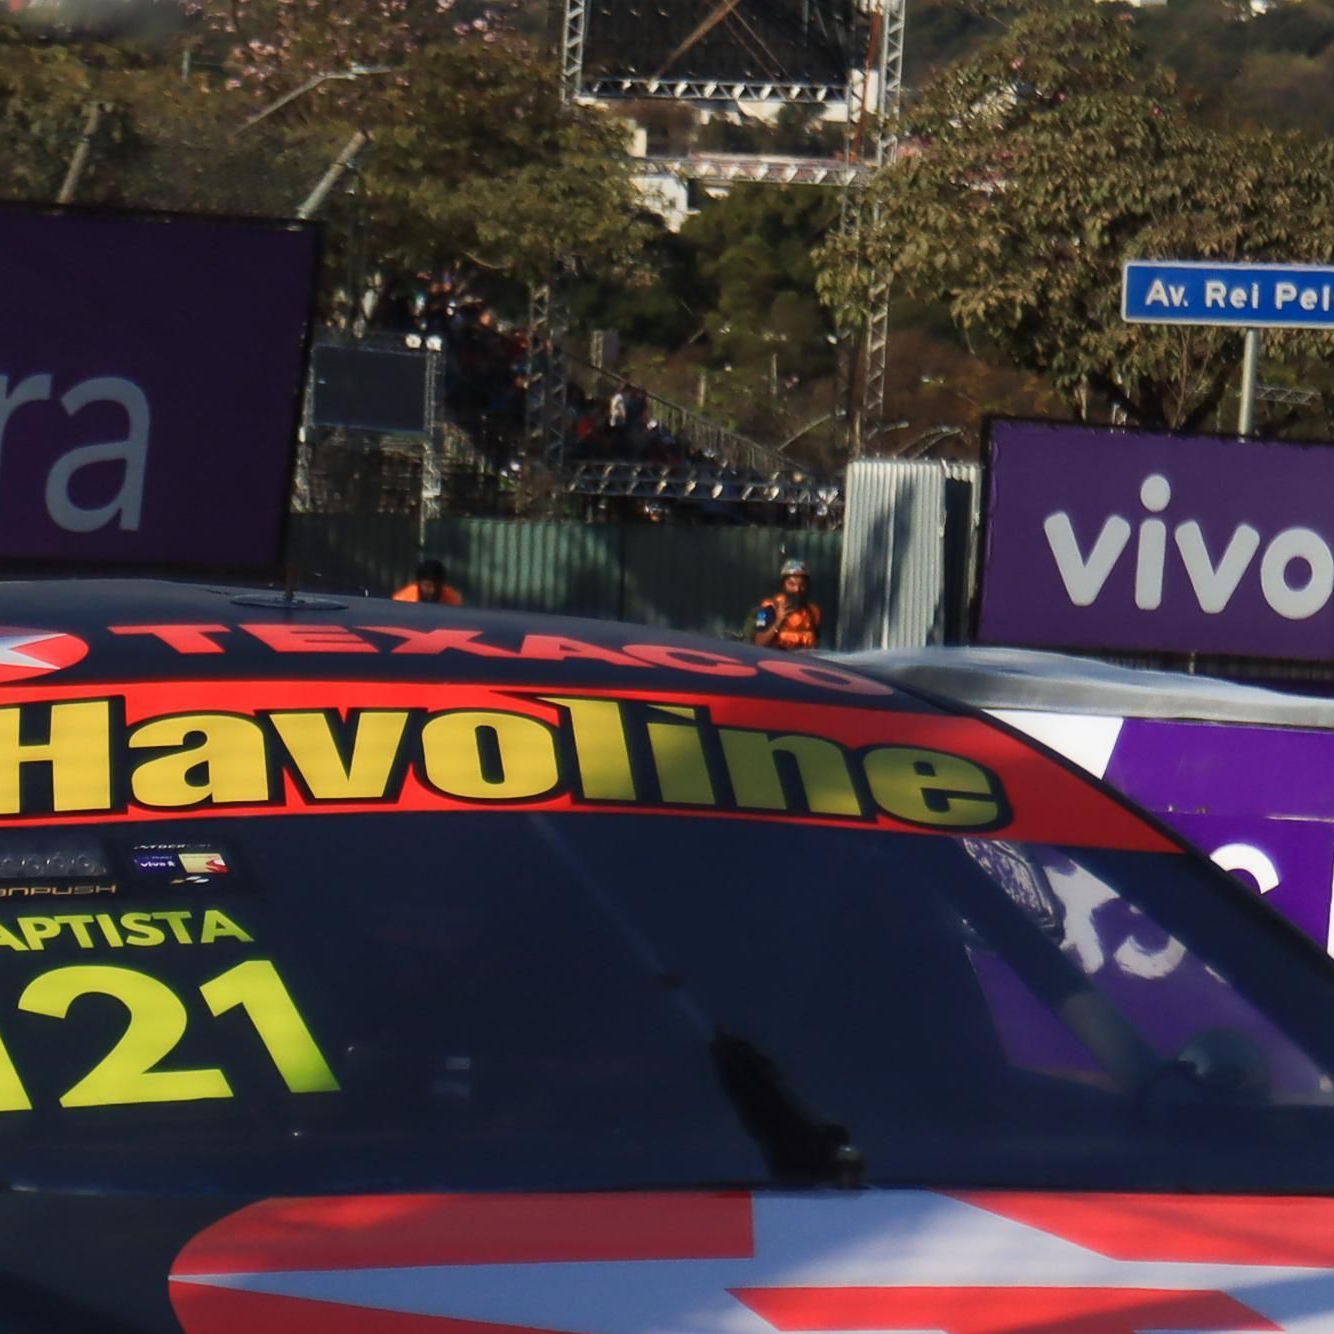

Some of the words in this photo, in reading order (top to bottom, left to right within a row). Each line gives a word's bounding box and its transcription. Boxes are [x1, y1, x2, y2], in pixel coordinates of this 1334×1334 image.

[1145, 279, 1189, 308] Av.
[1205, 279, 1259, 310] Rei
[1043, 473, 1334, 620] vivo
[109, 623, 895, 696] TEXACO
